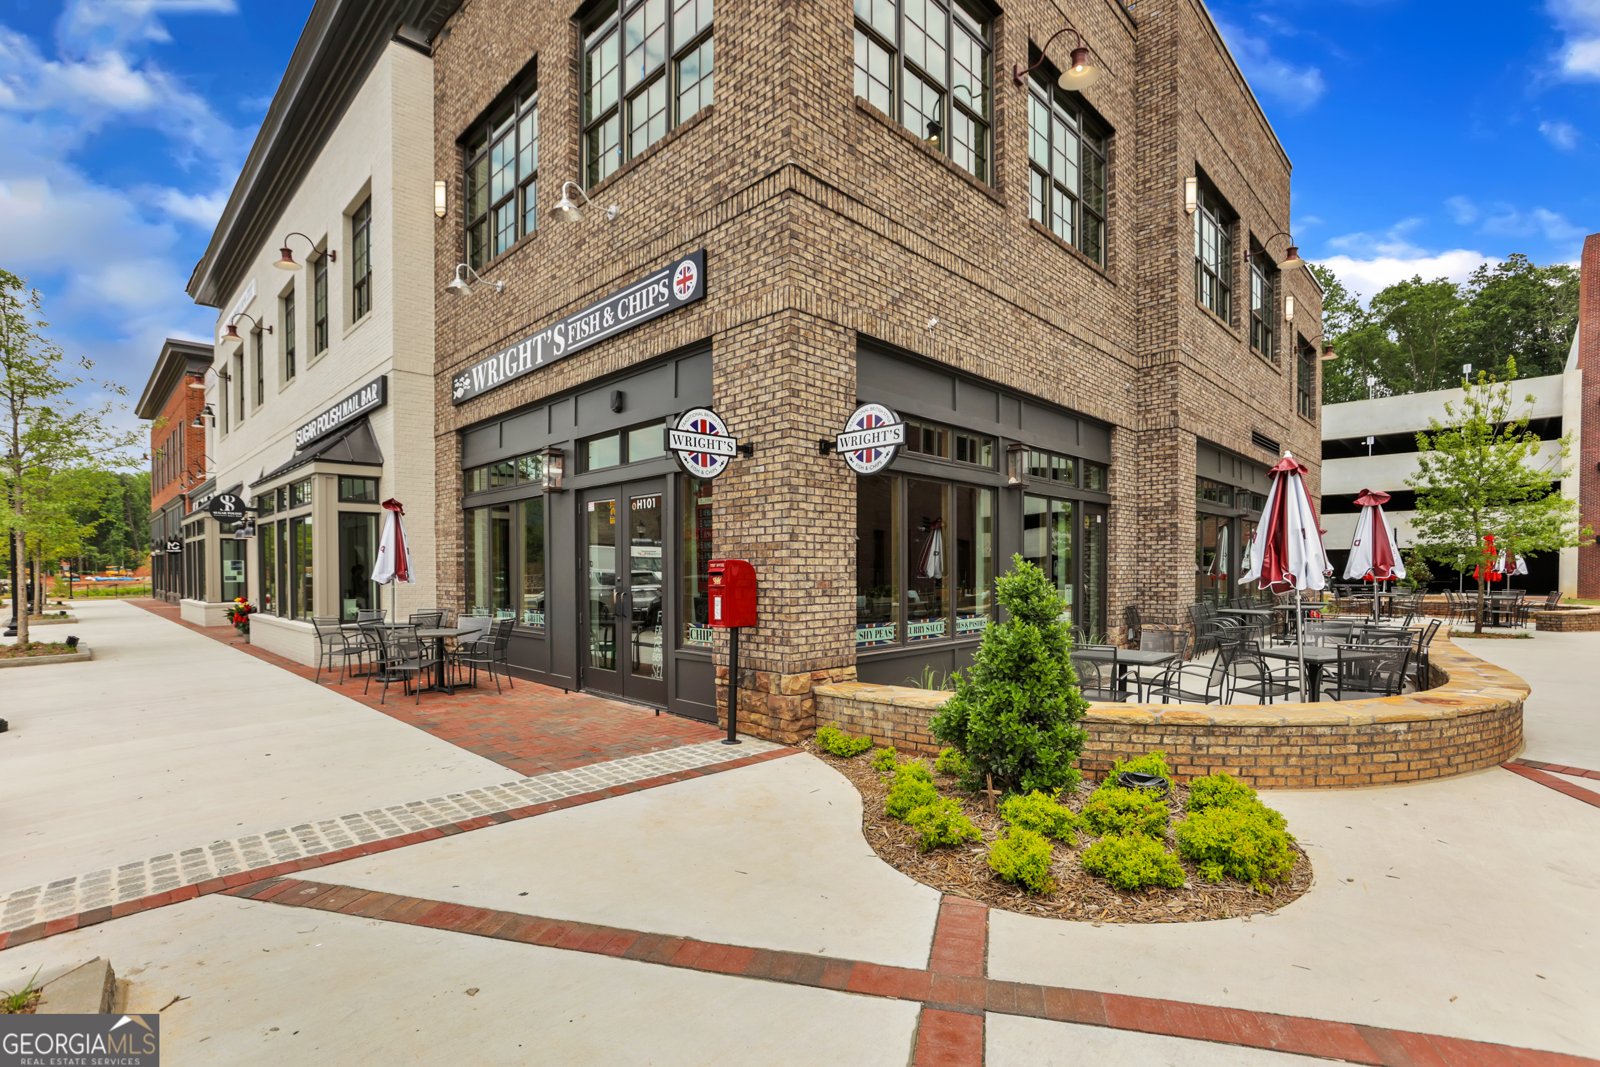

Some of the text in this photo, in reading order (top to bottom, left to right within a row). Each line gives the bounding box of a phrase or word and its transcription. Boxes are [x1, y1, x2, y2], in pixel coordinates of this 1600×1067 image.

[471, 321, 566, 393] WRIGHT'S
[567, 313, 600, 345] FISH
[602, 308, 615, 328] &
[617, 278, 669, 321] CHIPS
[296, 383, 378, 447] SUGAR POLISH NAIL BAR
[671, 433, 734, 452] WRIGHT'S
[839, 428, 900, 448] WRIGHT'S
[636, 497, 656, 510] H101
[874, 628, 893, 639] PEAS
[925, 623, 944, 633] SAUCE
